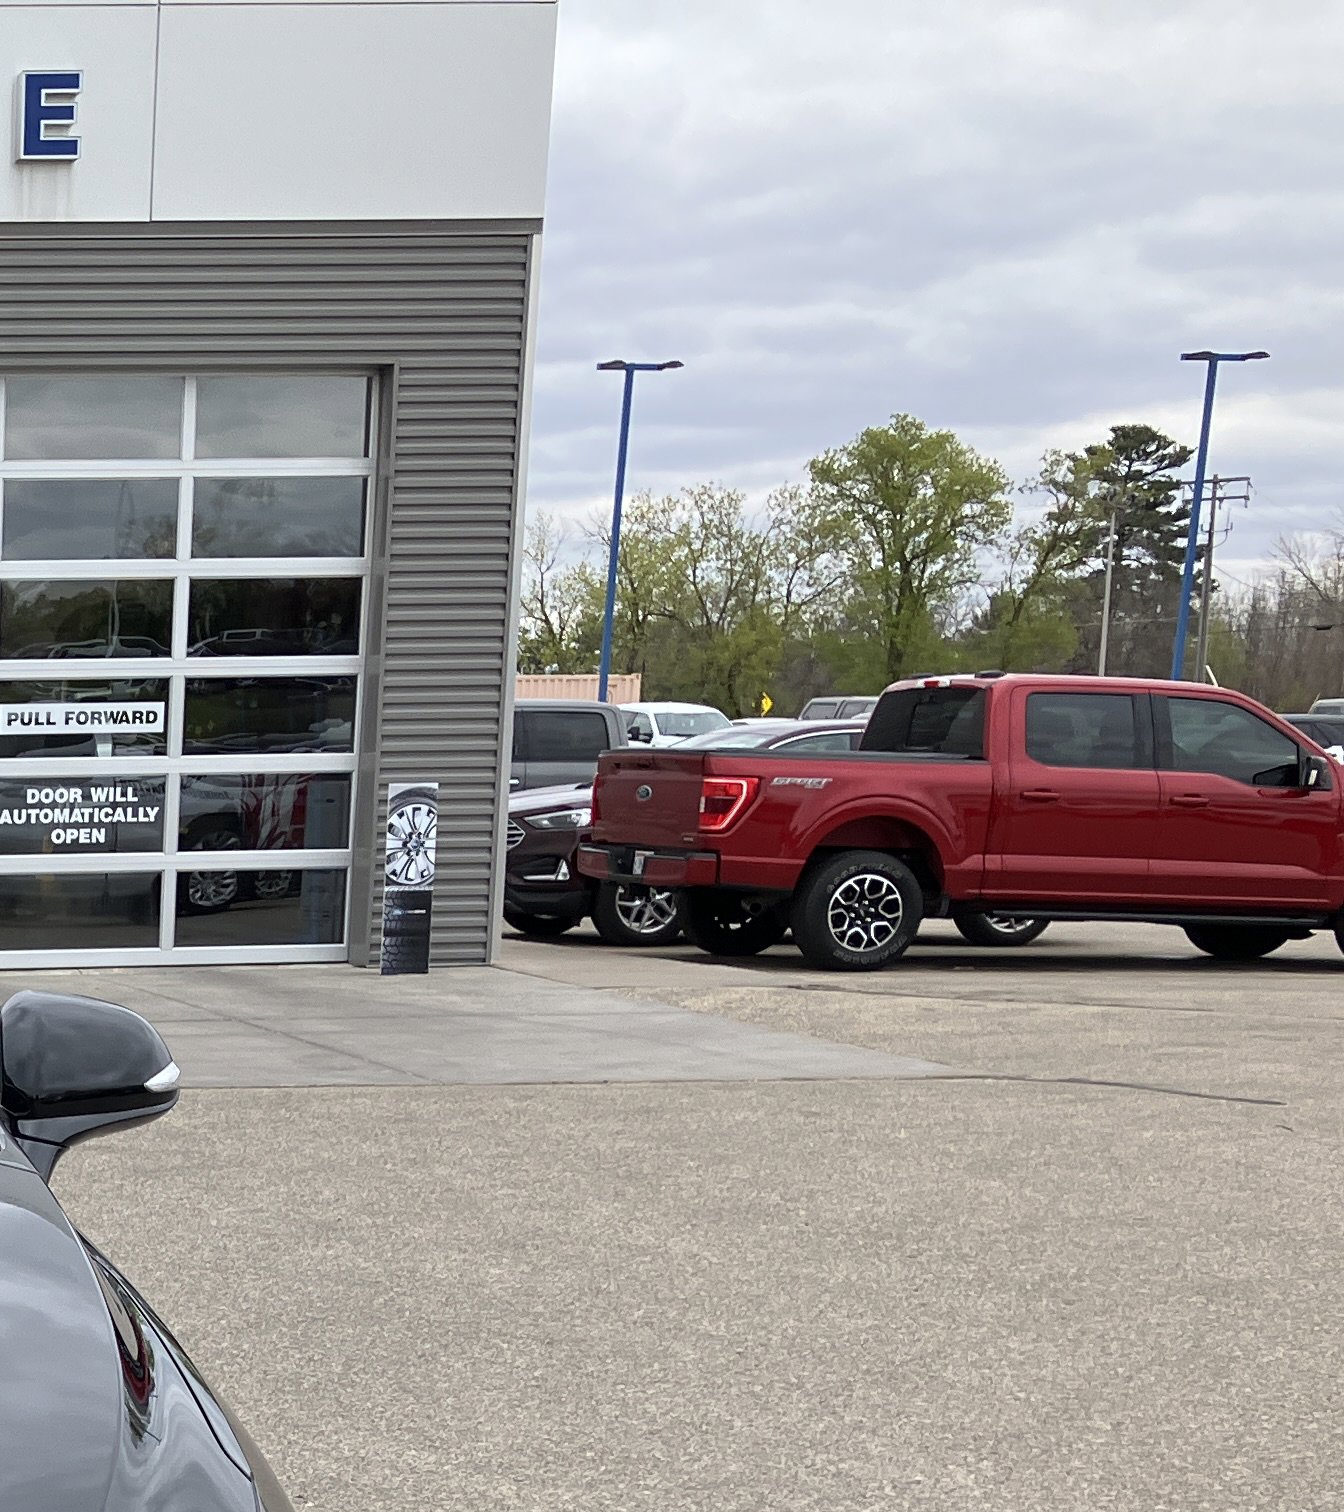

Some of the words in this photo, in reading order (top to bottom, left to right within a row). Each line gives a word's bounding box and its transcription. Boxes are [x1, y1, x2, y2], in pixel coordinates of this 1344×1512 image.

[6, 711, 57, 727] PULL
[64, 710, 159, 726] FORWARD
[26, 787, 83, 804] DOOR
[90, 786, 139, 803] WILL
[50, 828, 106, 845] OPEN
